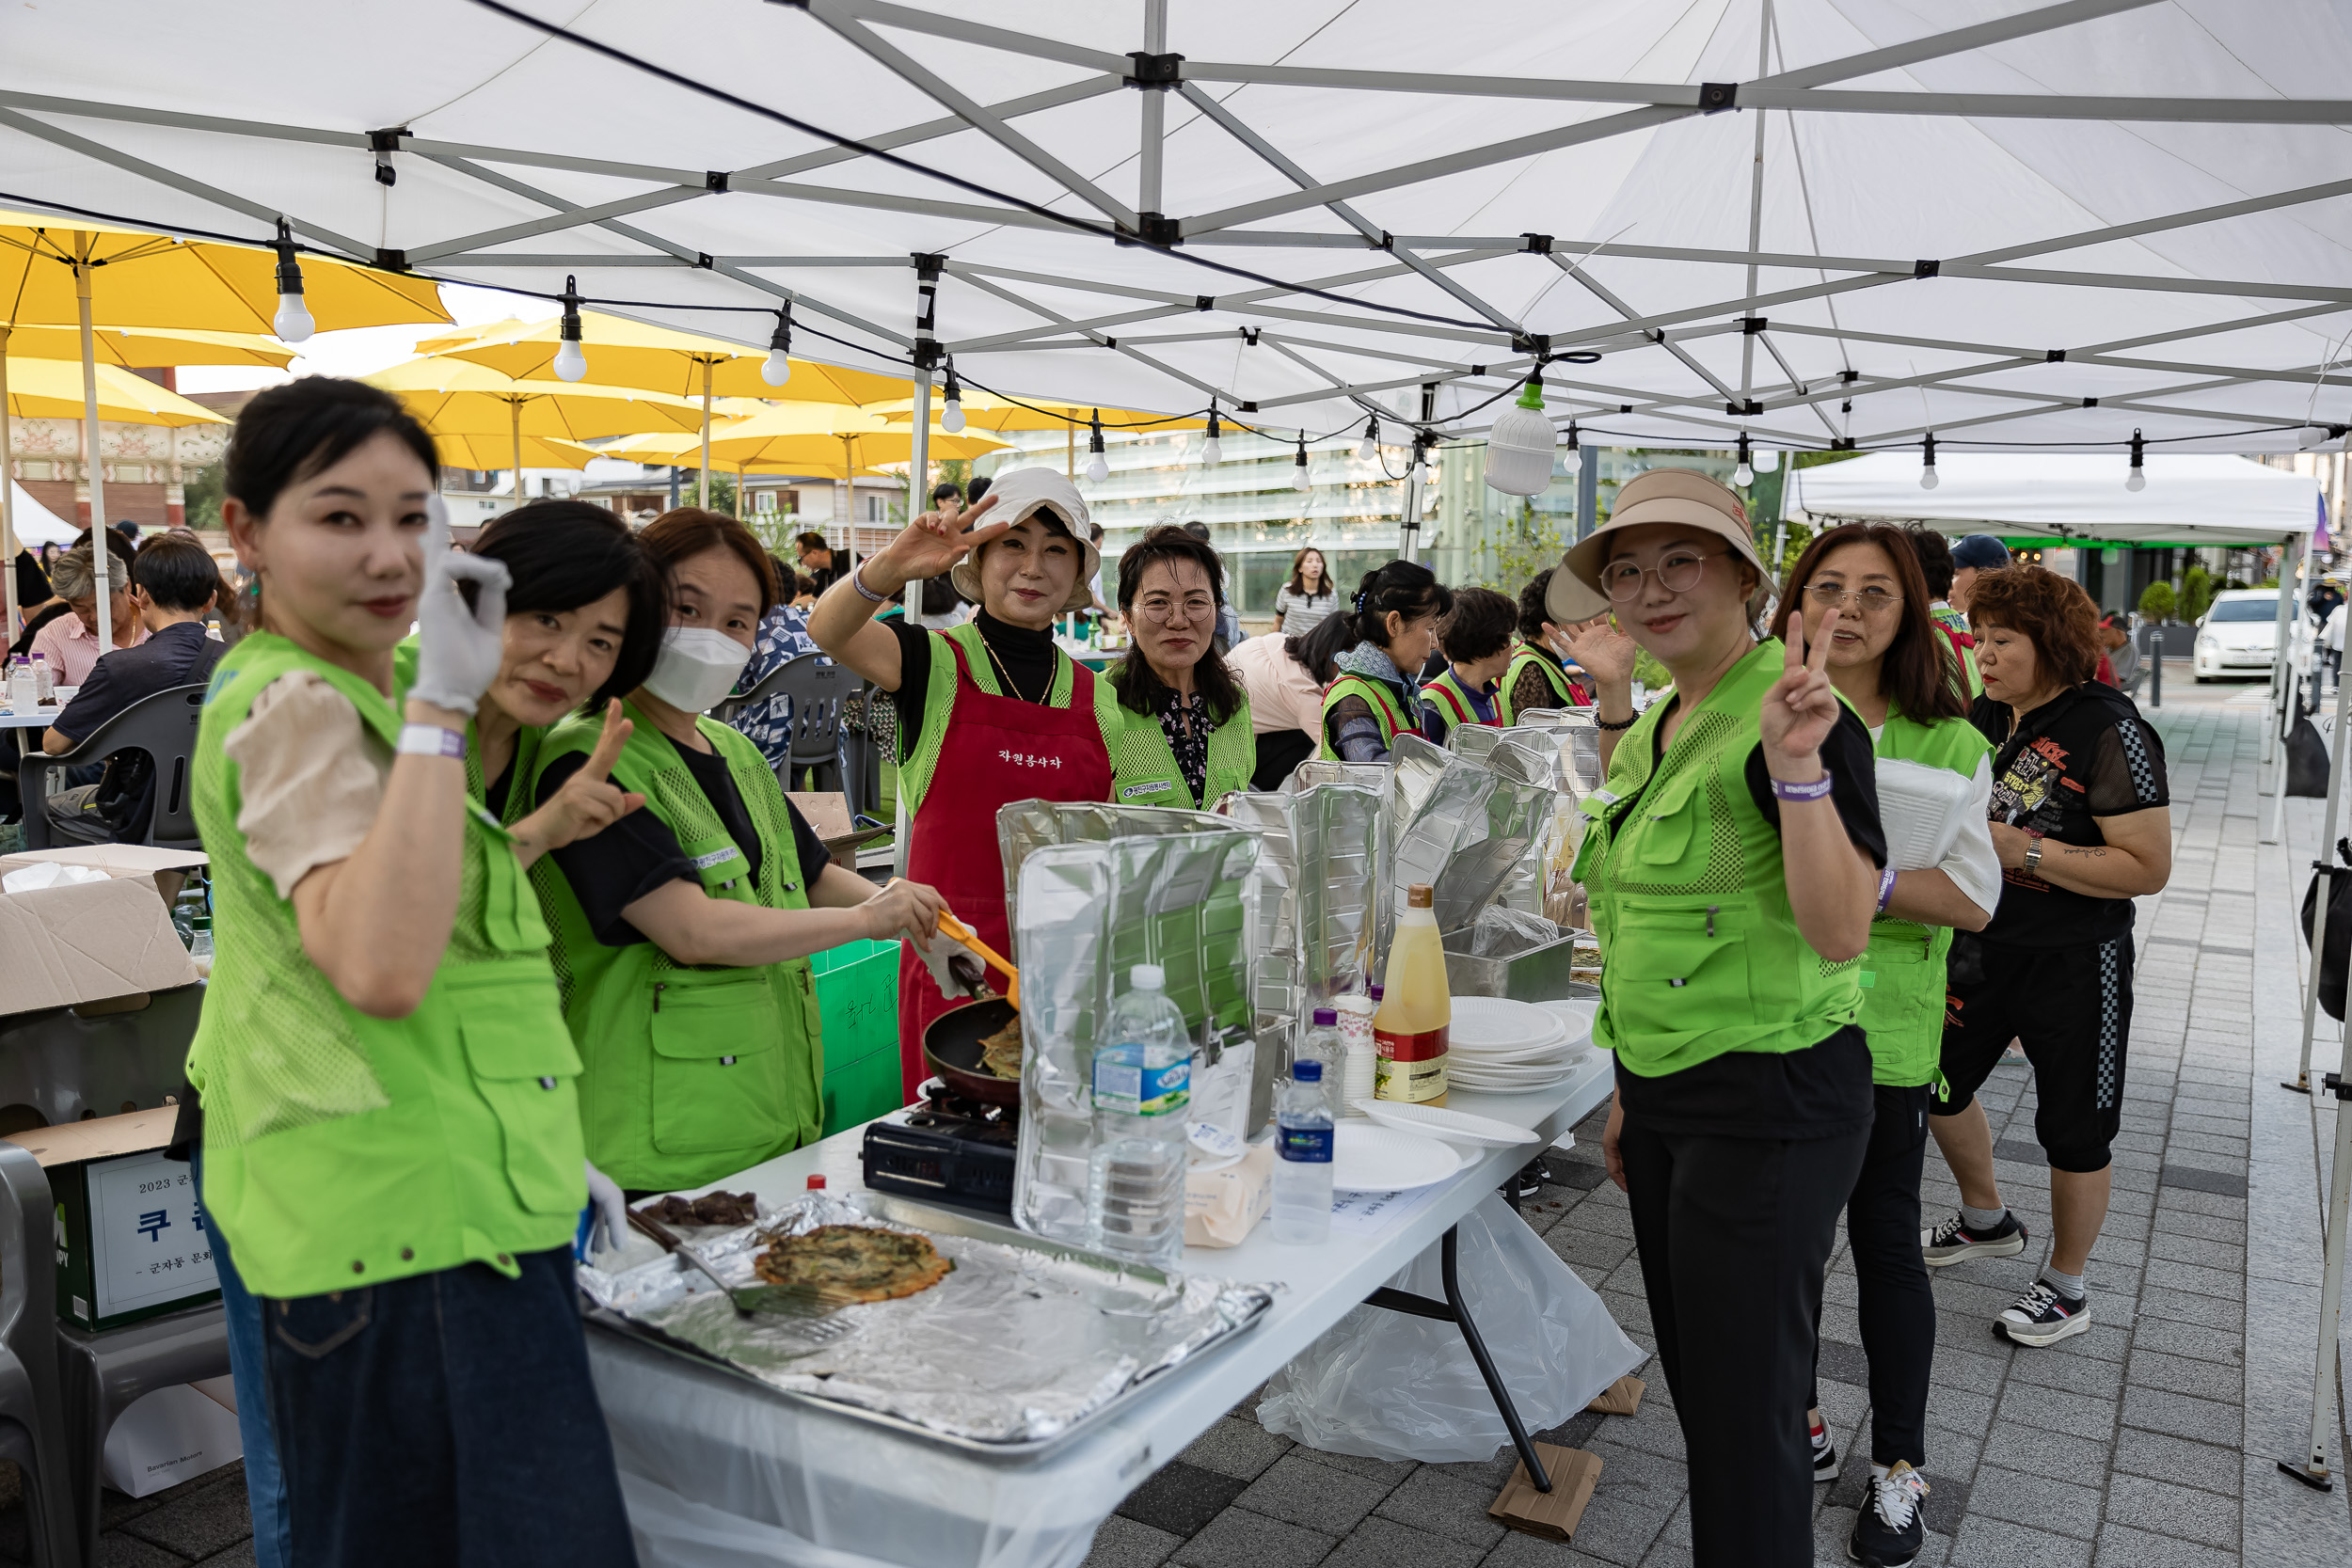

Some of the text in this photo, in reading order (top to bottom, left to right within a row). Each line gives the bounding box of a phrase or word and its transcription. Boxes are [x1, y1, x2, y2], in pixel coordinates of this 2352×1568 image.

[998, 750, 1062, 769] 자원봉사자
[2004, 771, 2029, 793] STREET
[139, 1179, 171, 1194] 2023
[149, 1256, 185, 1275] 군자동
[147, 1459, 178, 1473] Bavarian
[180, 1450, 203, 1464] Motors
